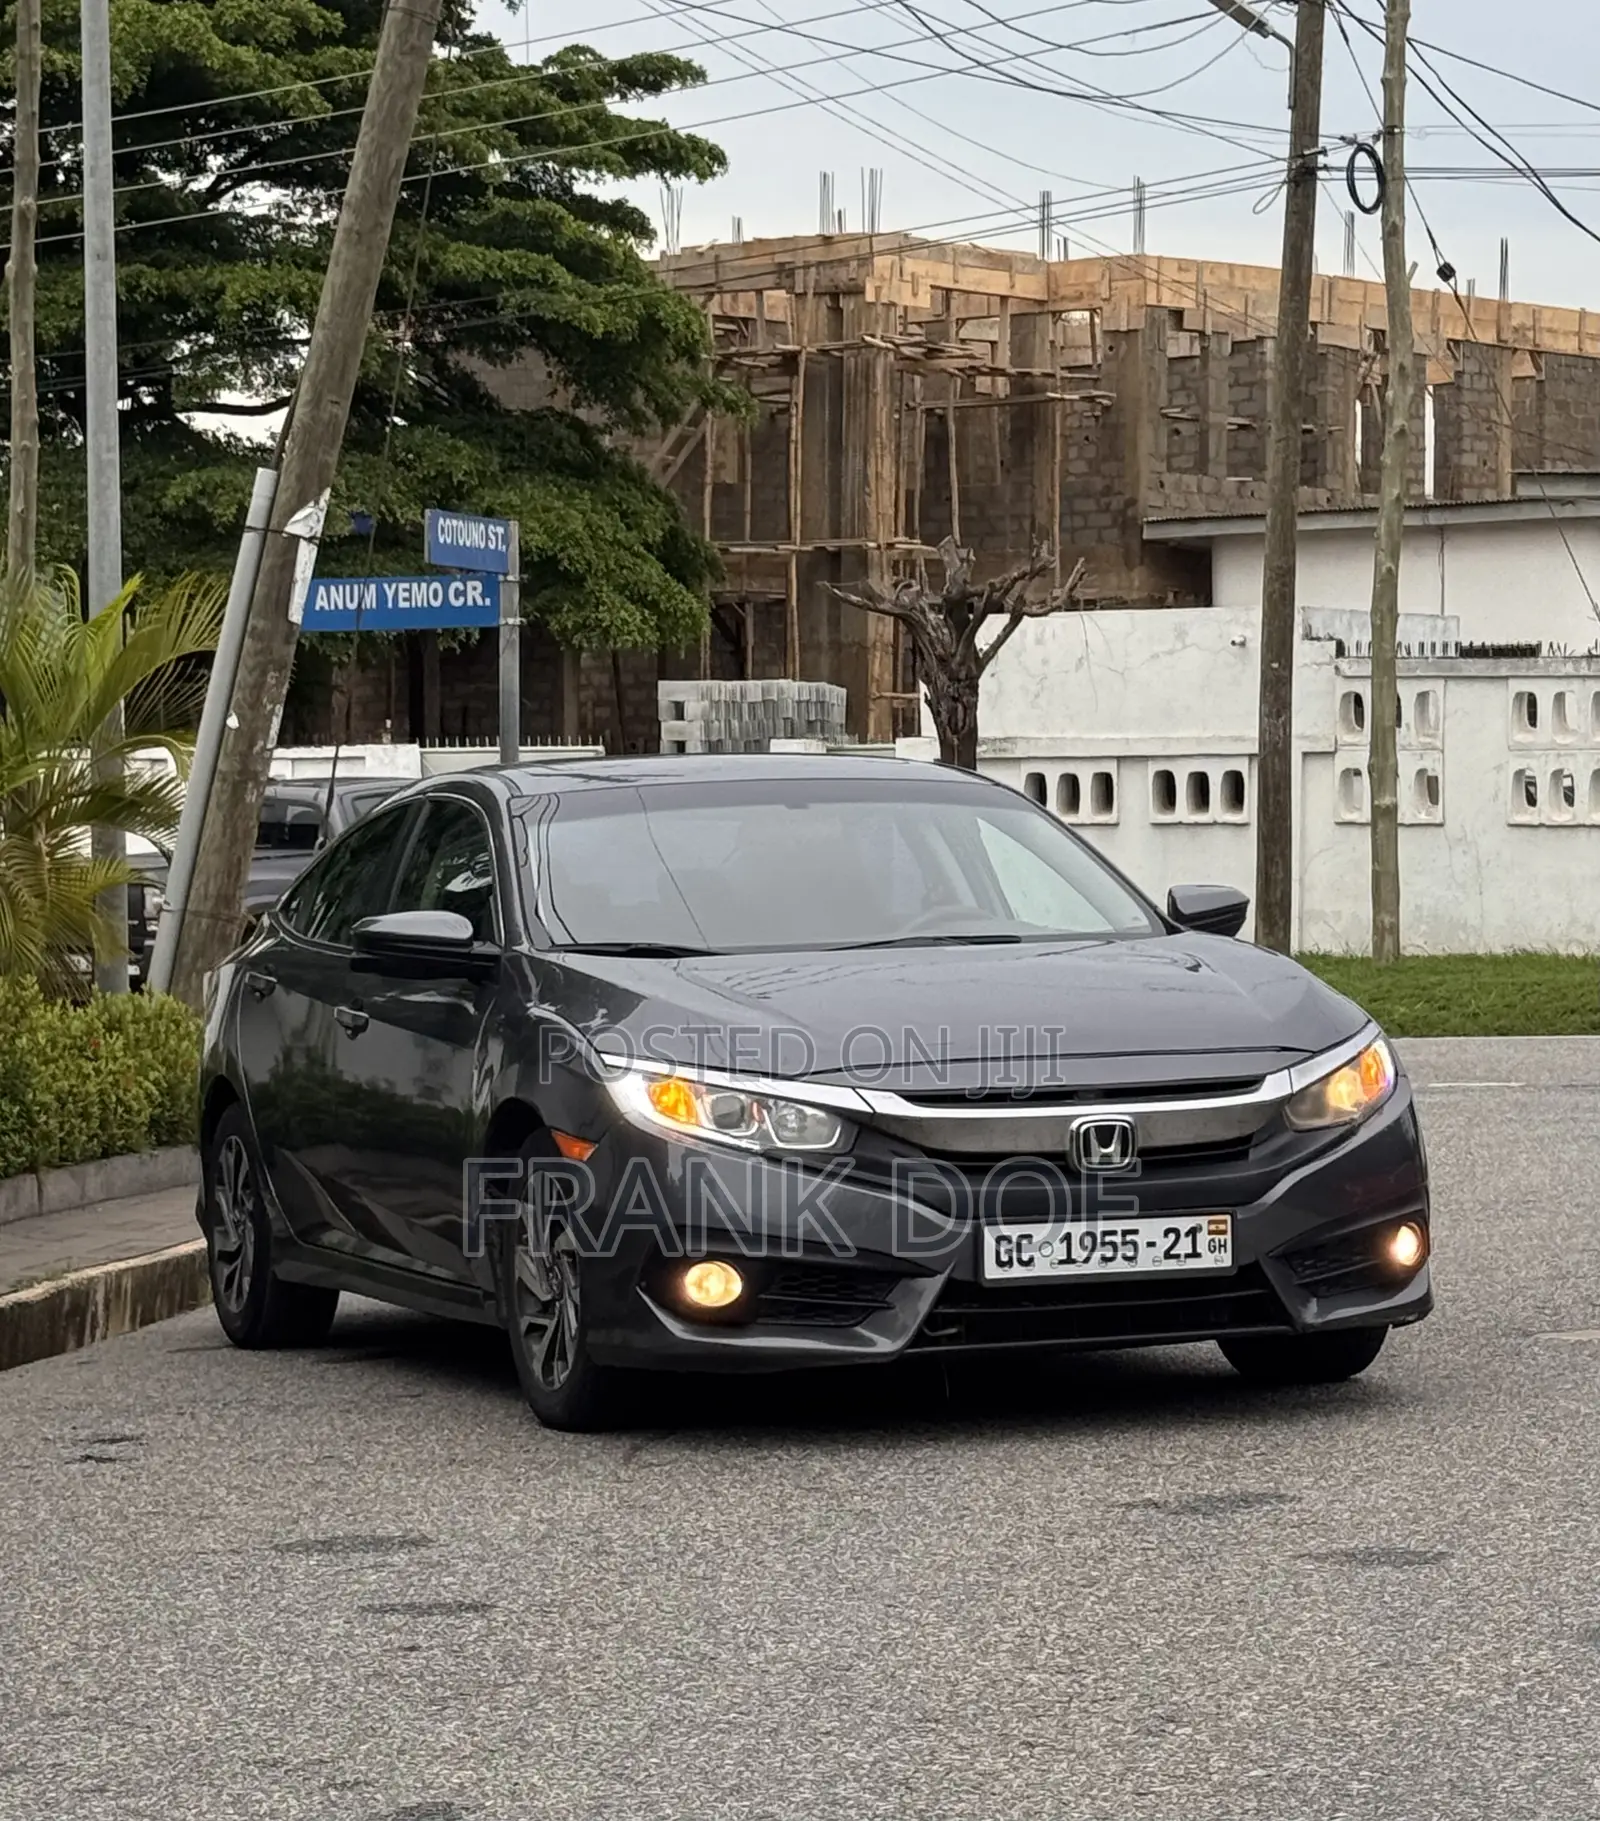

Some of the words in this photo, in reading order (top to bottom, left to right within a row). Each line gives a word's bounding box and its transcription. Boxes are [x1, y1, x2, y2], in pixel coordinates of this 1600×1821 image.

[438, 517, 486, 547] COTOUNO
[488, 526, 507, 553] ST.
[314, 583, 377, 611] ANUM
[382, 581, 443, 609] YEMO
[449, 580, 491, 607] CR.
[995, 1233, 1034, 1270] GC
[1208, 1237, 1227, 1254] GH
